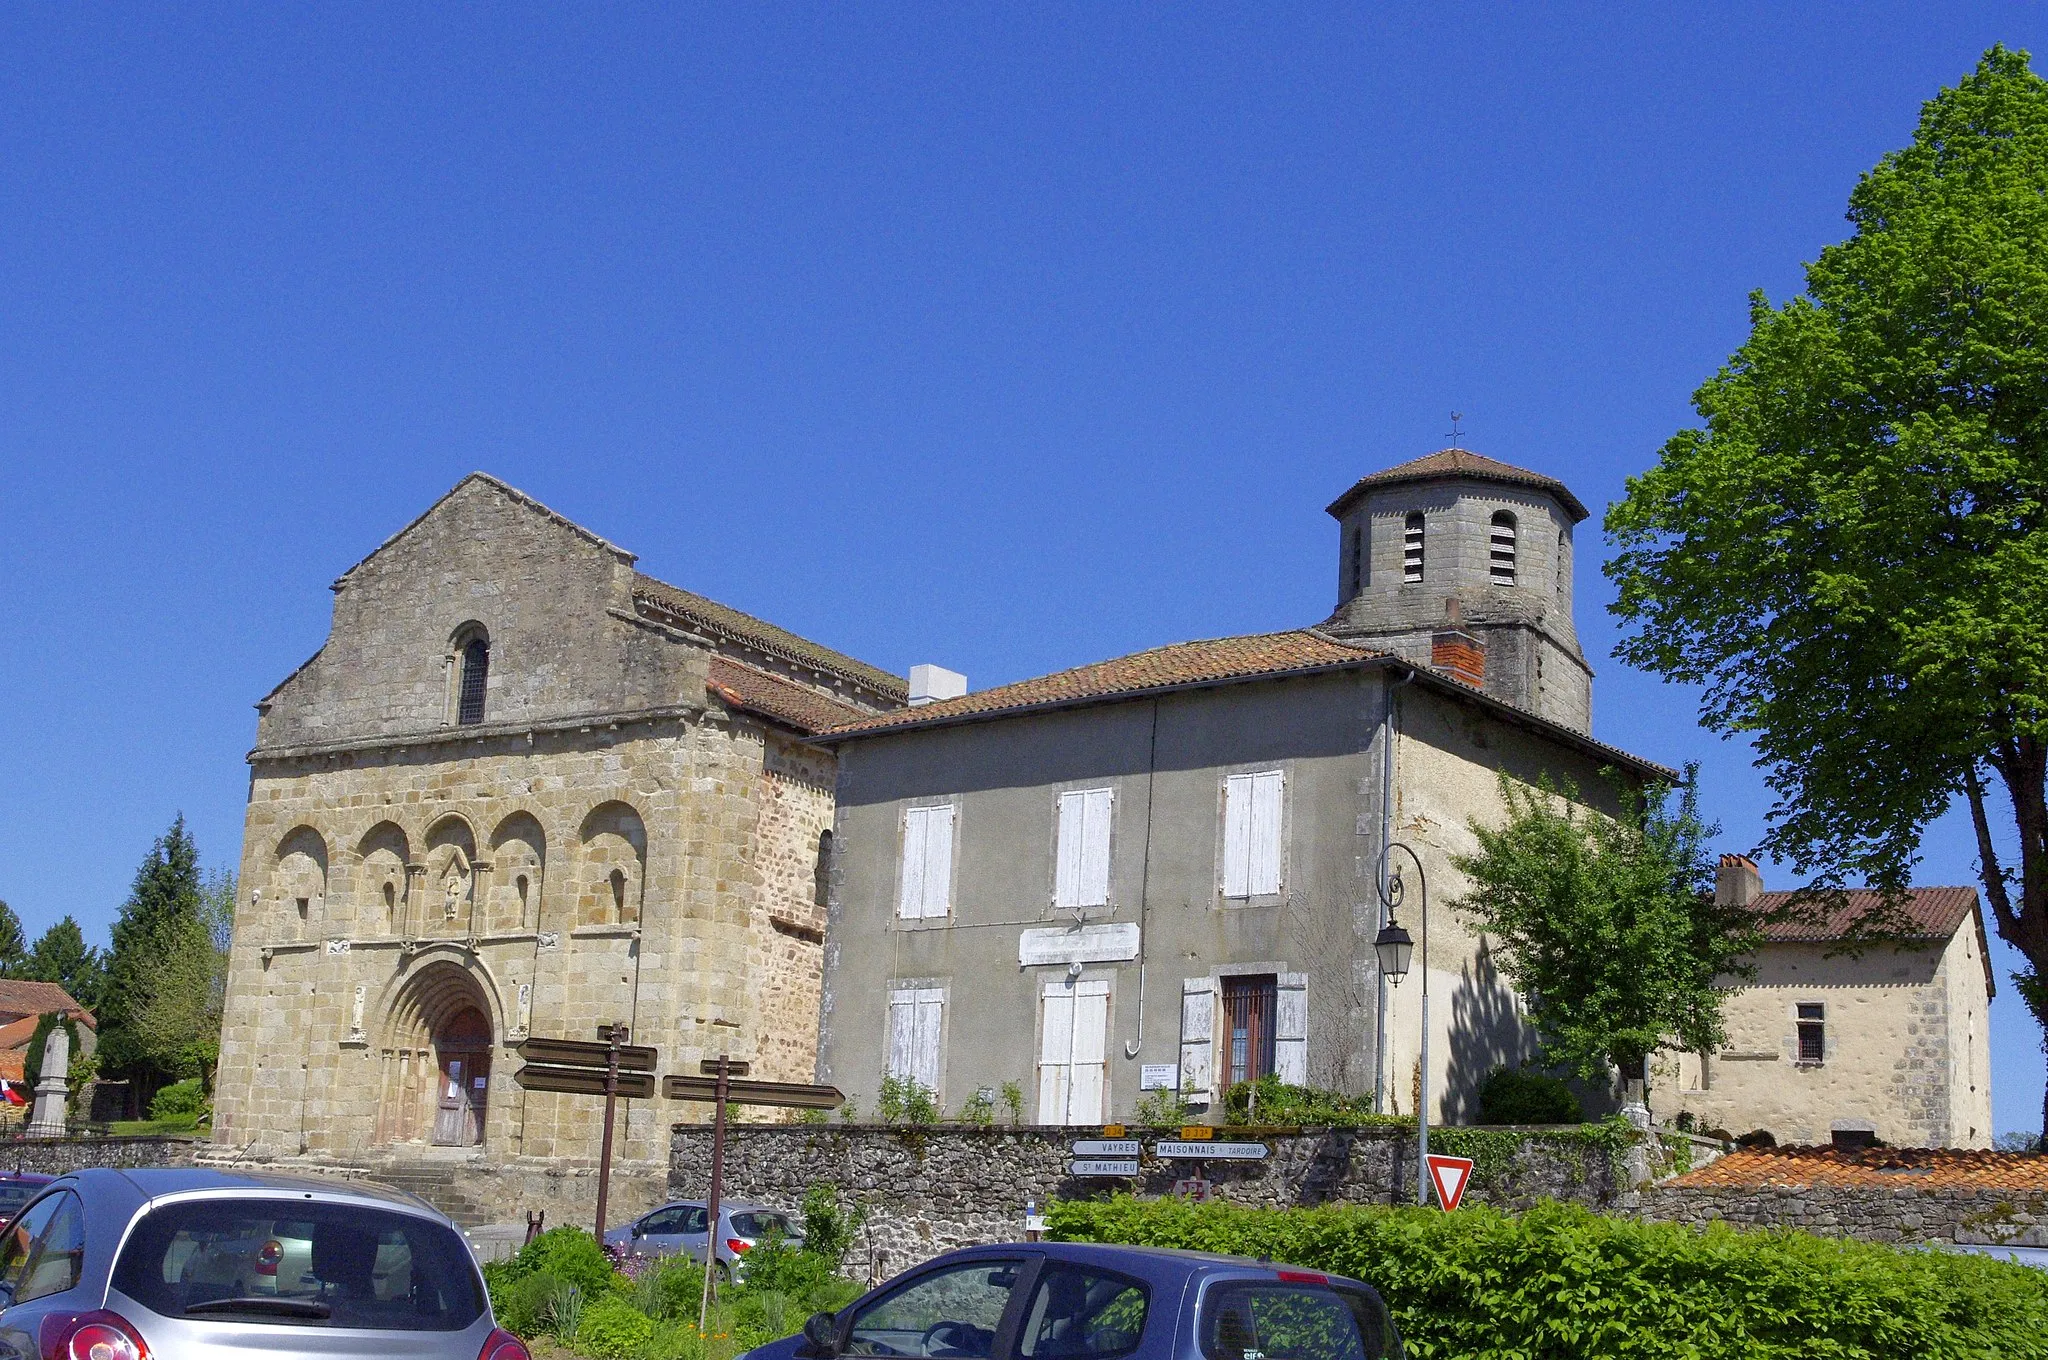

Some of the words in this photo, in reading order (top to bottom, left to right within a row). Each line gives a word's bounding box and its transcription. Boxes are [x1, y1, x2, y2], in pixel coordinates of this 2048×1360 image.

[1185, 1128, 1191, 1137] D
[1102, 1143, 1136, 1152] VAYRES
[1159, 1145, 1215, 1154] MAISONNAIS
[1228, 1147, 1262, 1155] TARDOIRE
[1095, 1163, 1135, 1172] MATHIEU
